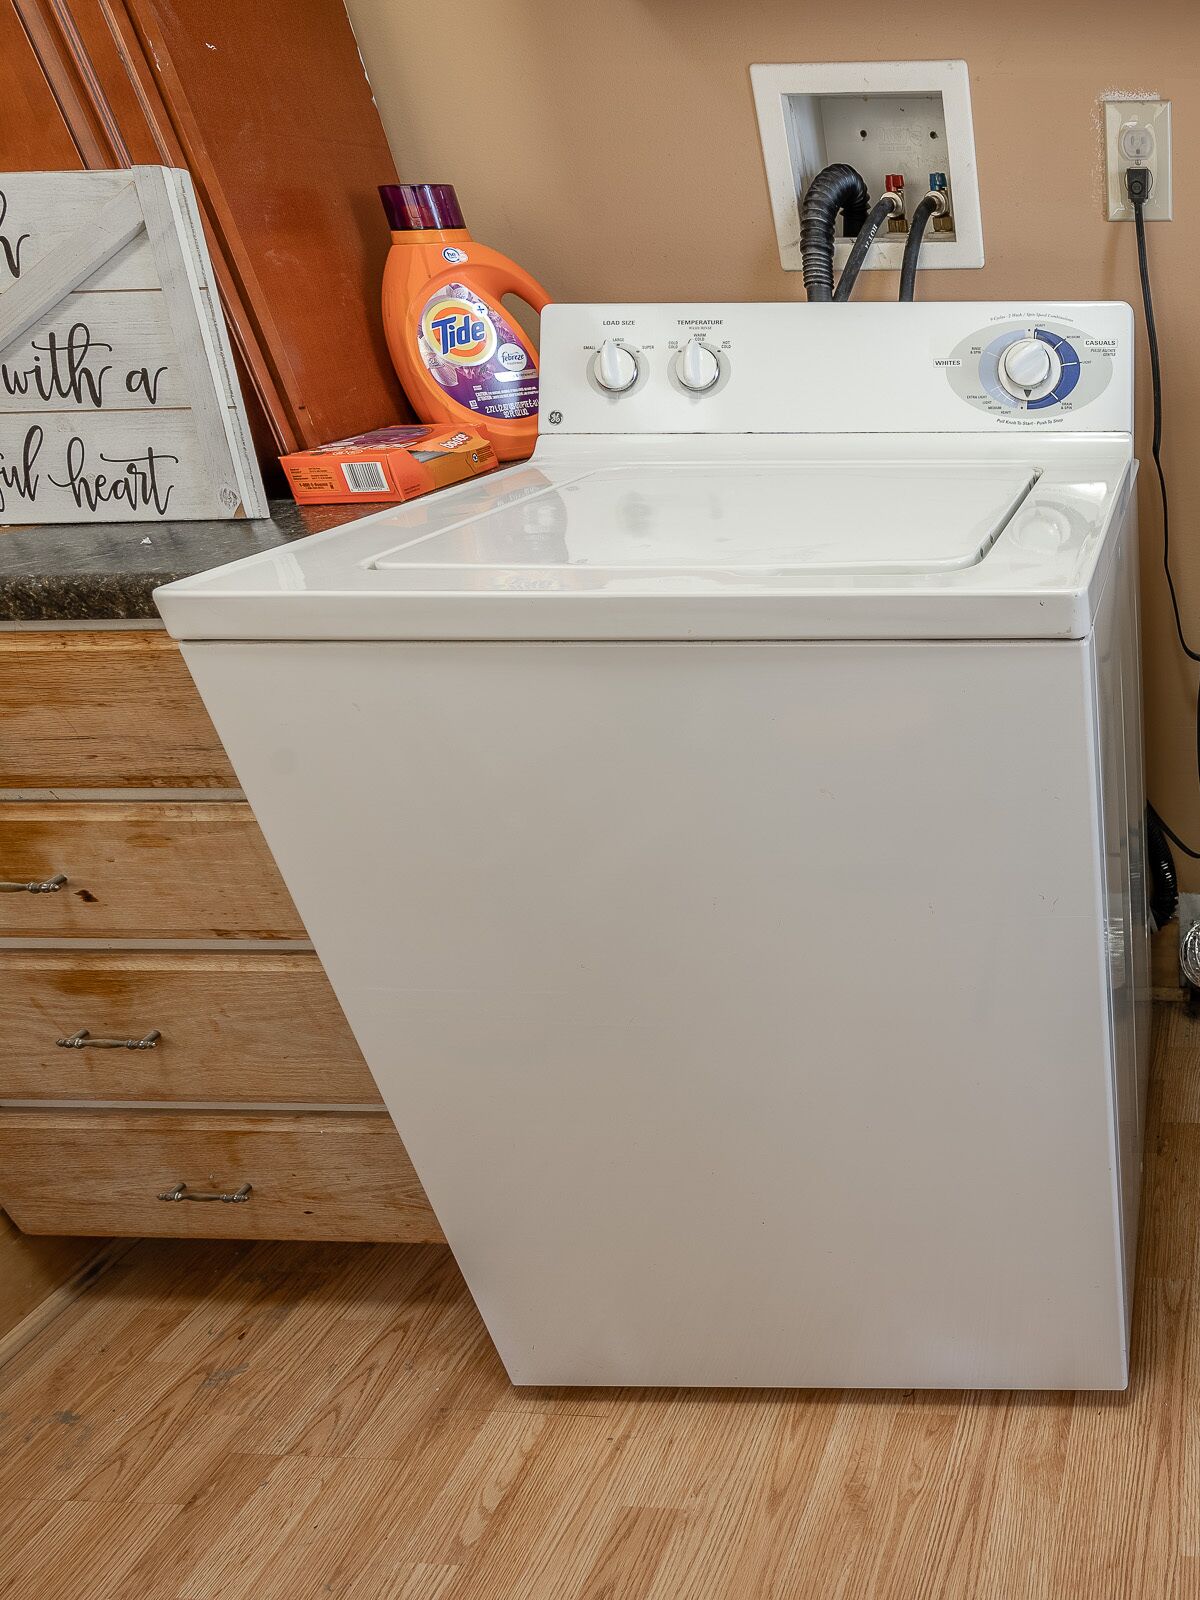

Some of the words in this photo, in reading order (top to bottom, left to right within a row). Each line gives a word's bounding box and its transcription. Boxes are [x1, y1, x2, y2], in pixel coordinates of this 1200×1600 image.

[2, 323, 112, 408] with
[126, 366, 168, 404] a
[431, 315, 485, 355] Tide
[501, 351, 525, 363] febreze
[0, 425, 43, 512] ul
[48, 437, 178, 515] heart
